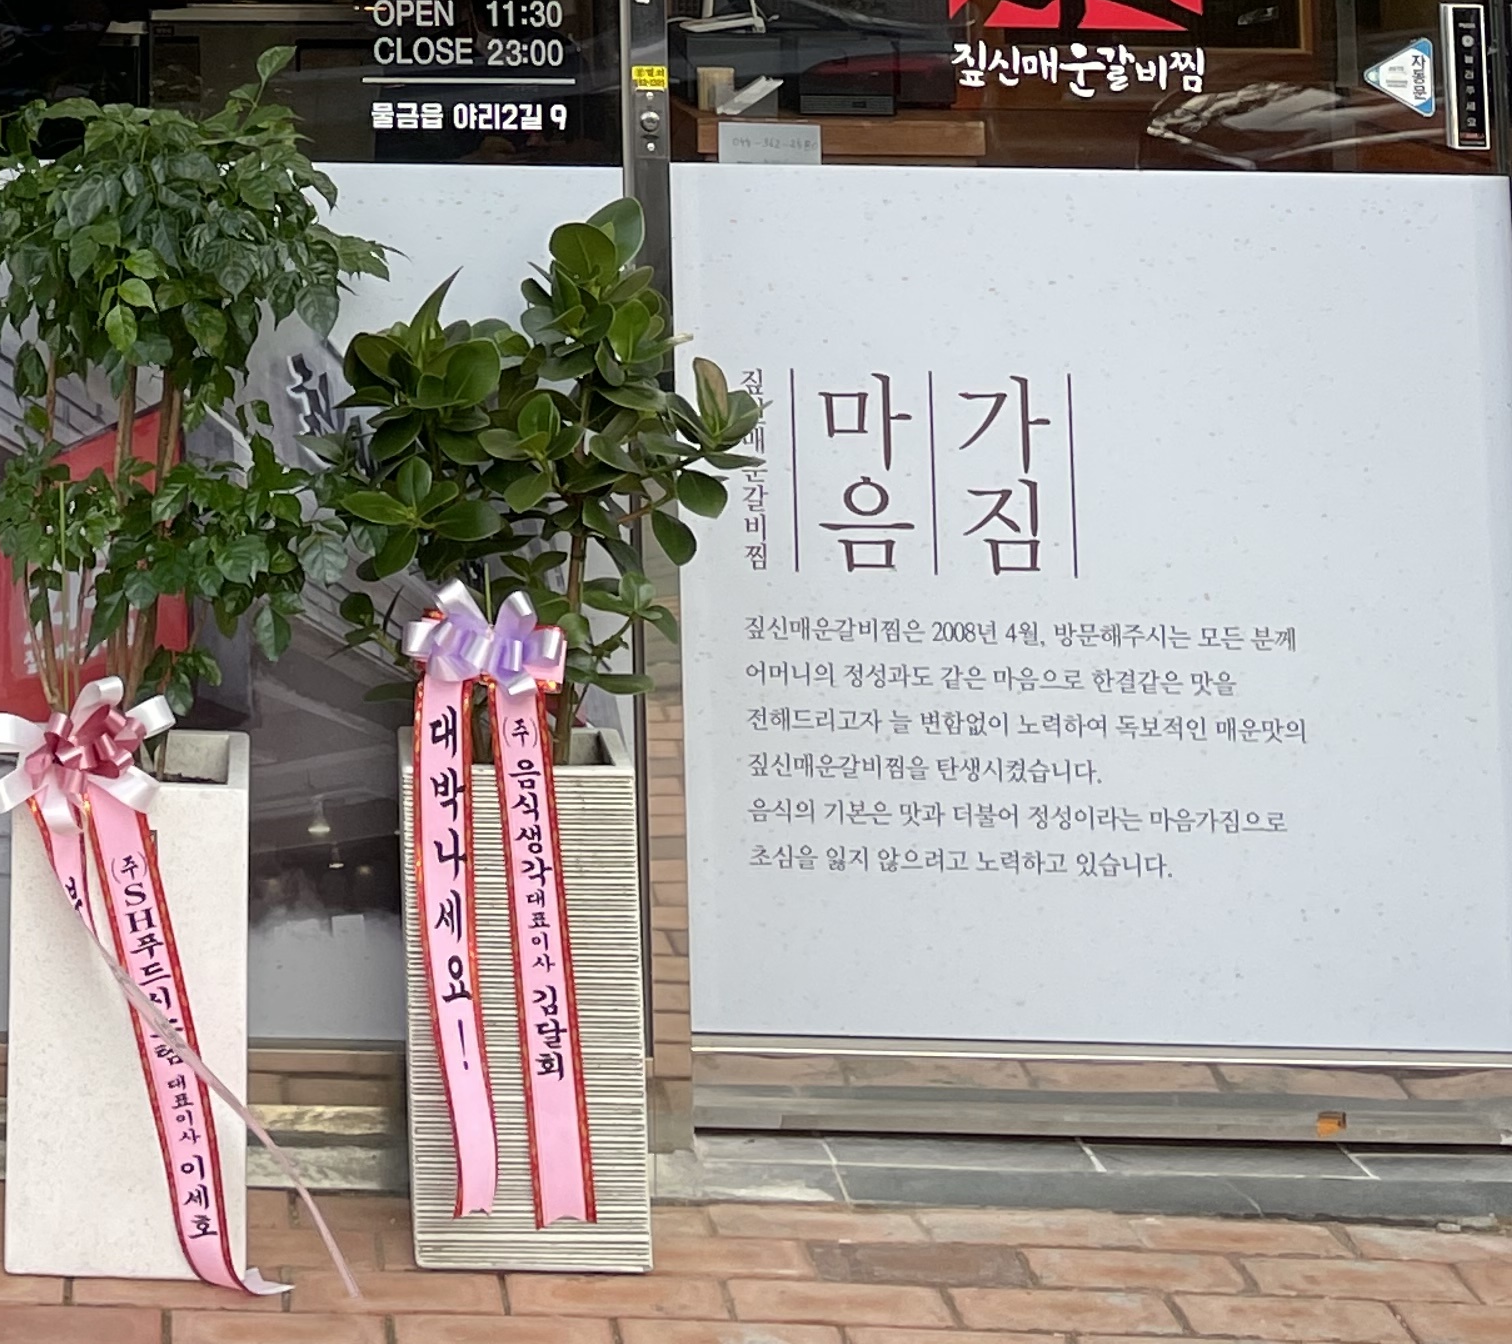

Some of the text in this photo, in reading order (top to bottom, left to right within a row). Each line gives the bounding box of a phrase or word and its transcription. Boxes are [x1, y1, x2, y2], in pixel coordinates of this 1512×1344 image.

[373, 0, 564, 29] OPEN 11:30
[373, 37, 565, 68] CLOSE 23:00
[950, 41, 1206, 98] 짚신매운갈비찜
[370, 101, 568, 132] 물금읍 야리2길 9
[744, 615, 1297, 653] 짚신매운갈비찜은 2008년 4월, 방문해주시는 모든 분께
[745, 661, 1238, 697] 어머니의 정성과도 같은 마음으로 한결같은 맛을
[746, 705, 1307, 745] 전해드리고자 늘 변함없이 노력하여 독보적인 매운맛의
[748, 751, 1103, 786] 짚신매운갈비찜을 탄생시켰습니다.
[747, 797, 1289, 835] 음식의 기본은 맛과 더불어 정성이라는 마음가짐으로
[749, 844, 1174, 879] 초심을 잃지 않으려고 노력하고 있습니다.
[180, 1154, 219, 1240] 이세호
